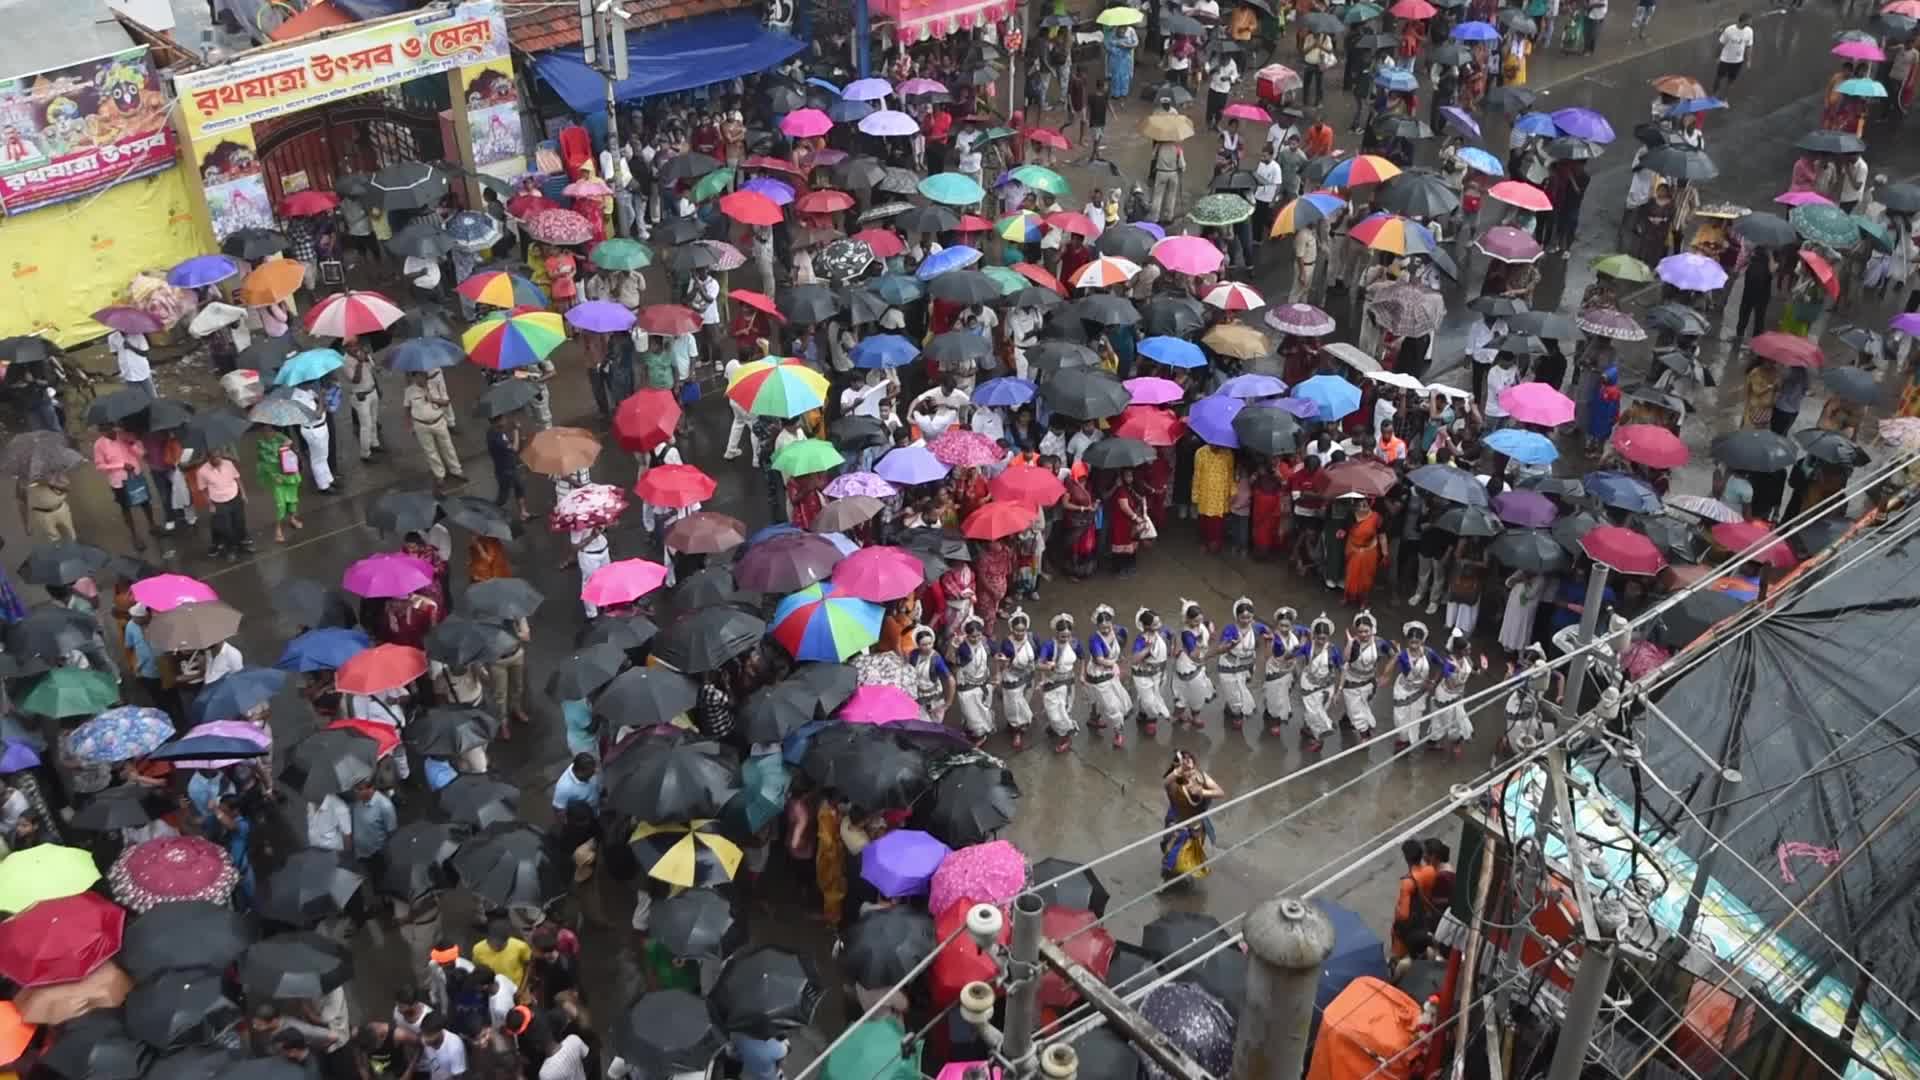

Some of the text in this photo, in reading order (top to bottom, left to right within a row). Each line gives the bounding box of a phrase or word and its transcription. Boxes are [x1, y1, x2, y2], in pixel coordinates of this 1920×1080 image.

[192, 66, 307, 116] রথযাত্রা
[310, 43, 394, 82] উৎসব
[401, 37, 422, 58] ও
[429, 19, 492, 58] মেলা
[2, 153, 99, 191] রথযাত্রা
[100, 132, 167, 163] উৎসব
